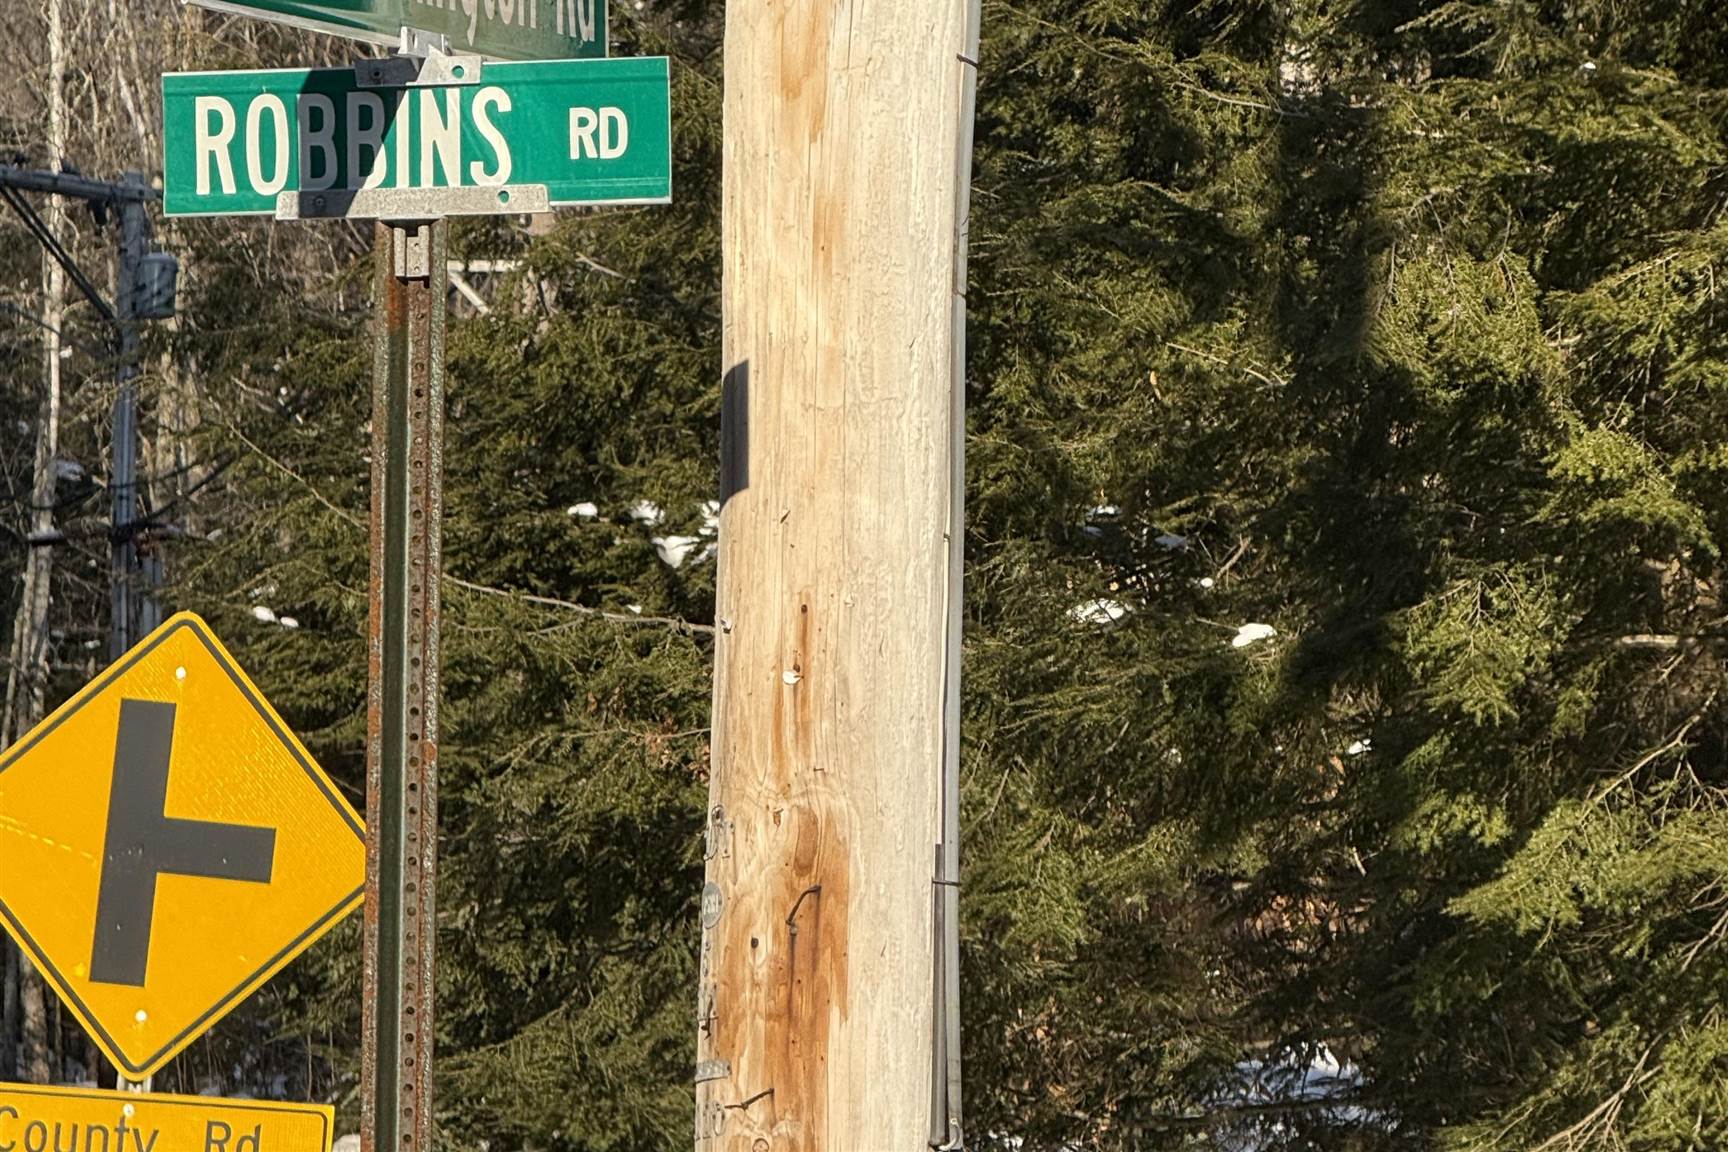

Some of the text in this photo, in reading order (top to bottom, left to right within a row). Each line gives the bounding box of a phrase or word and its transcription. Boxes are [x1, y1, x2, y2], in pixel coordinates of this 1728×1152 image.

[194, 86, 629, 196] ROBBINS RD
[204, 1120, 262, 1152] Rd
